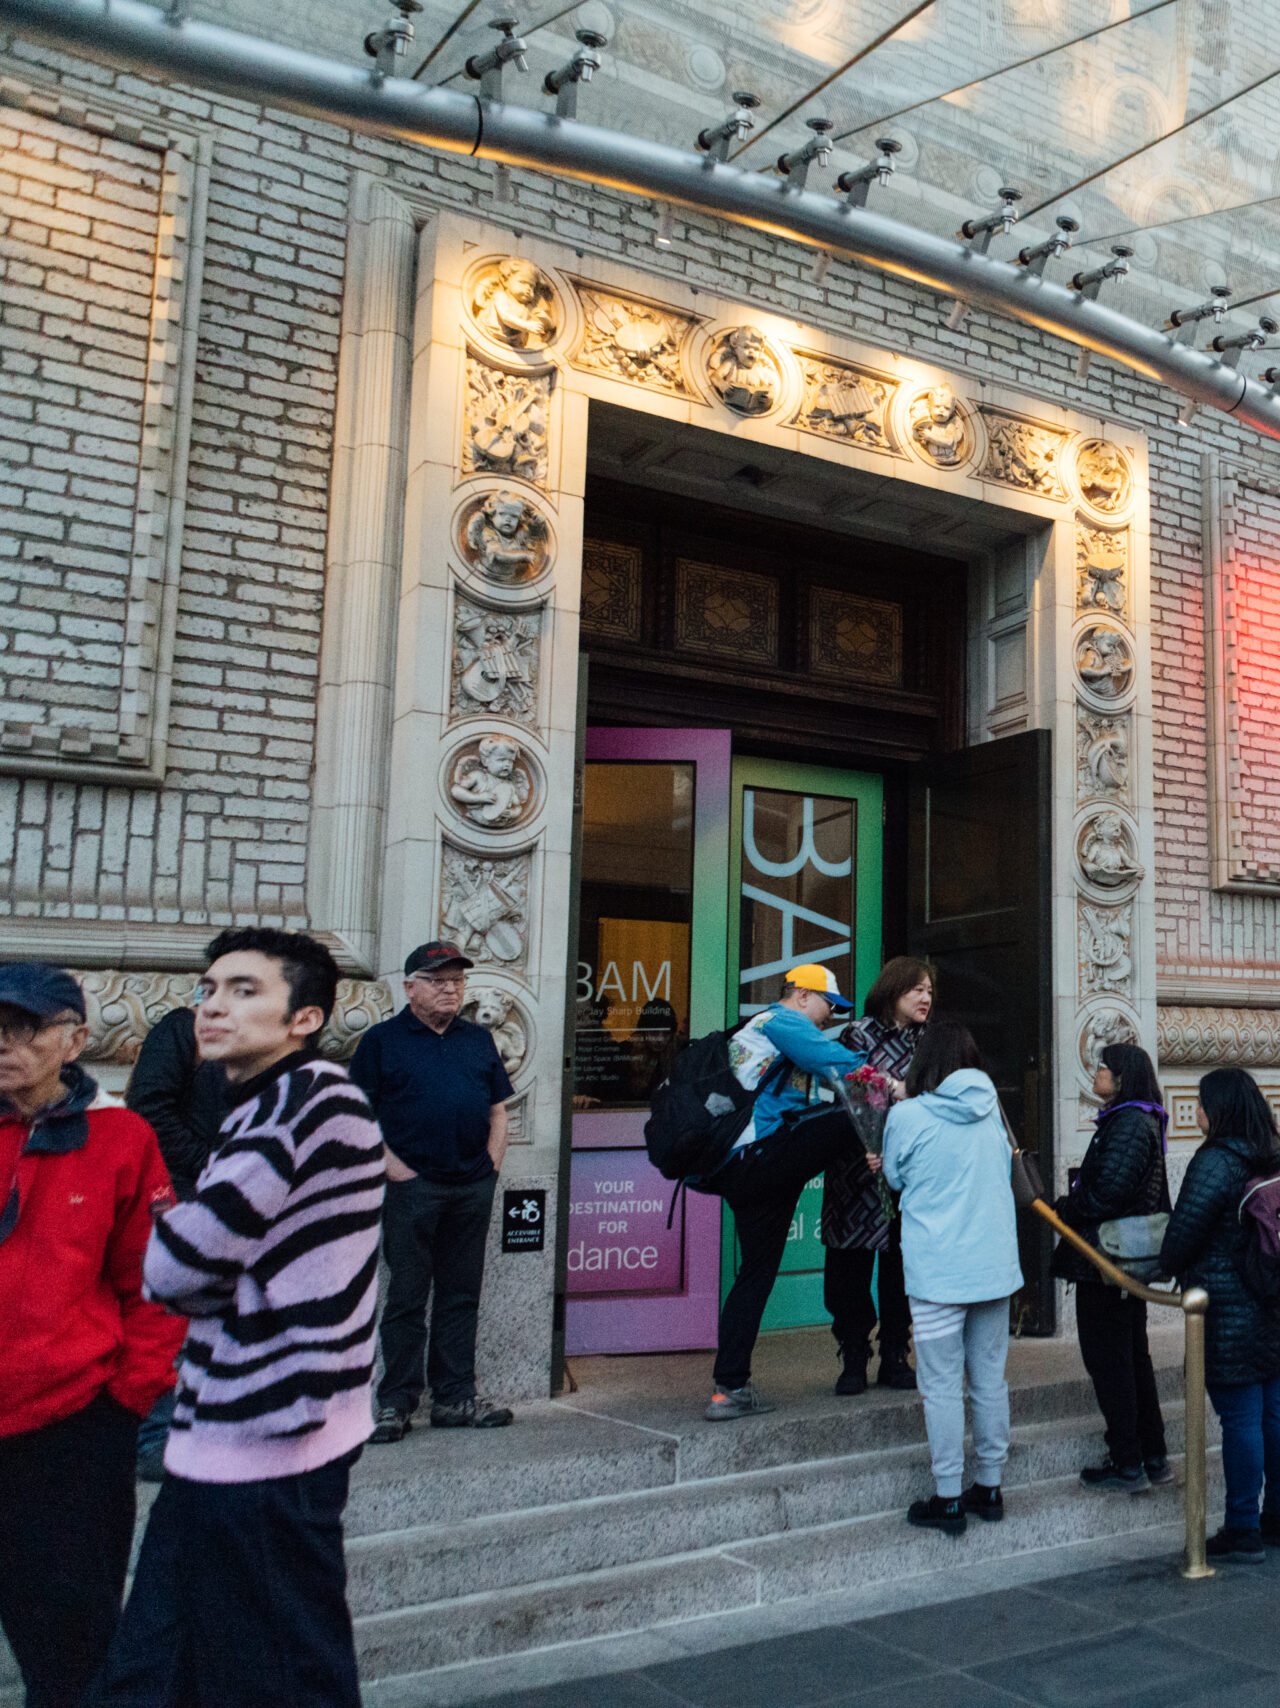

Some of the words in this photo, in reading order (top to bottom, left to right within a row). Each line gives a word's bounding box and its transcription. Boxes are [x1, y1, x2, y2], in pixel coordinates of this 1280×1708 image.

[740, 790, 852, 1040] BA
[576, 960, 671, 1002] BAM
[590, 1007, 604, 1017] Jay
[606, 1006, 633, 1017] Sharp
[635, 1006, 671, 1017] Building
[594, 1180, 635, 1194] YOUR
[598, 1221, 628, 1234] FOR
[567, 1241, 659, 1272] dance
